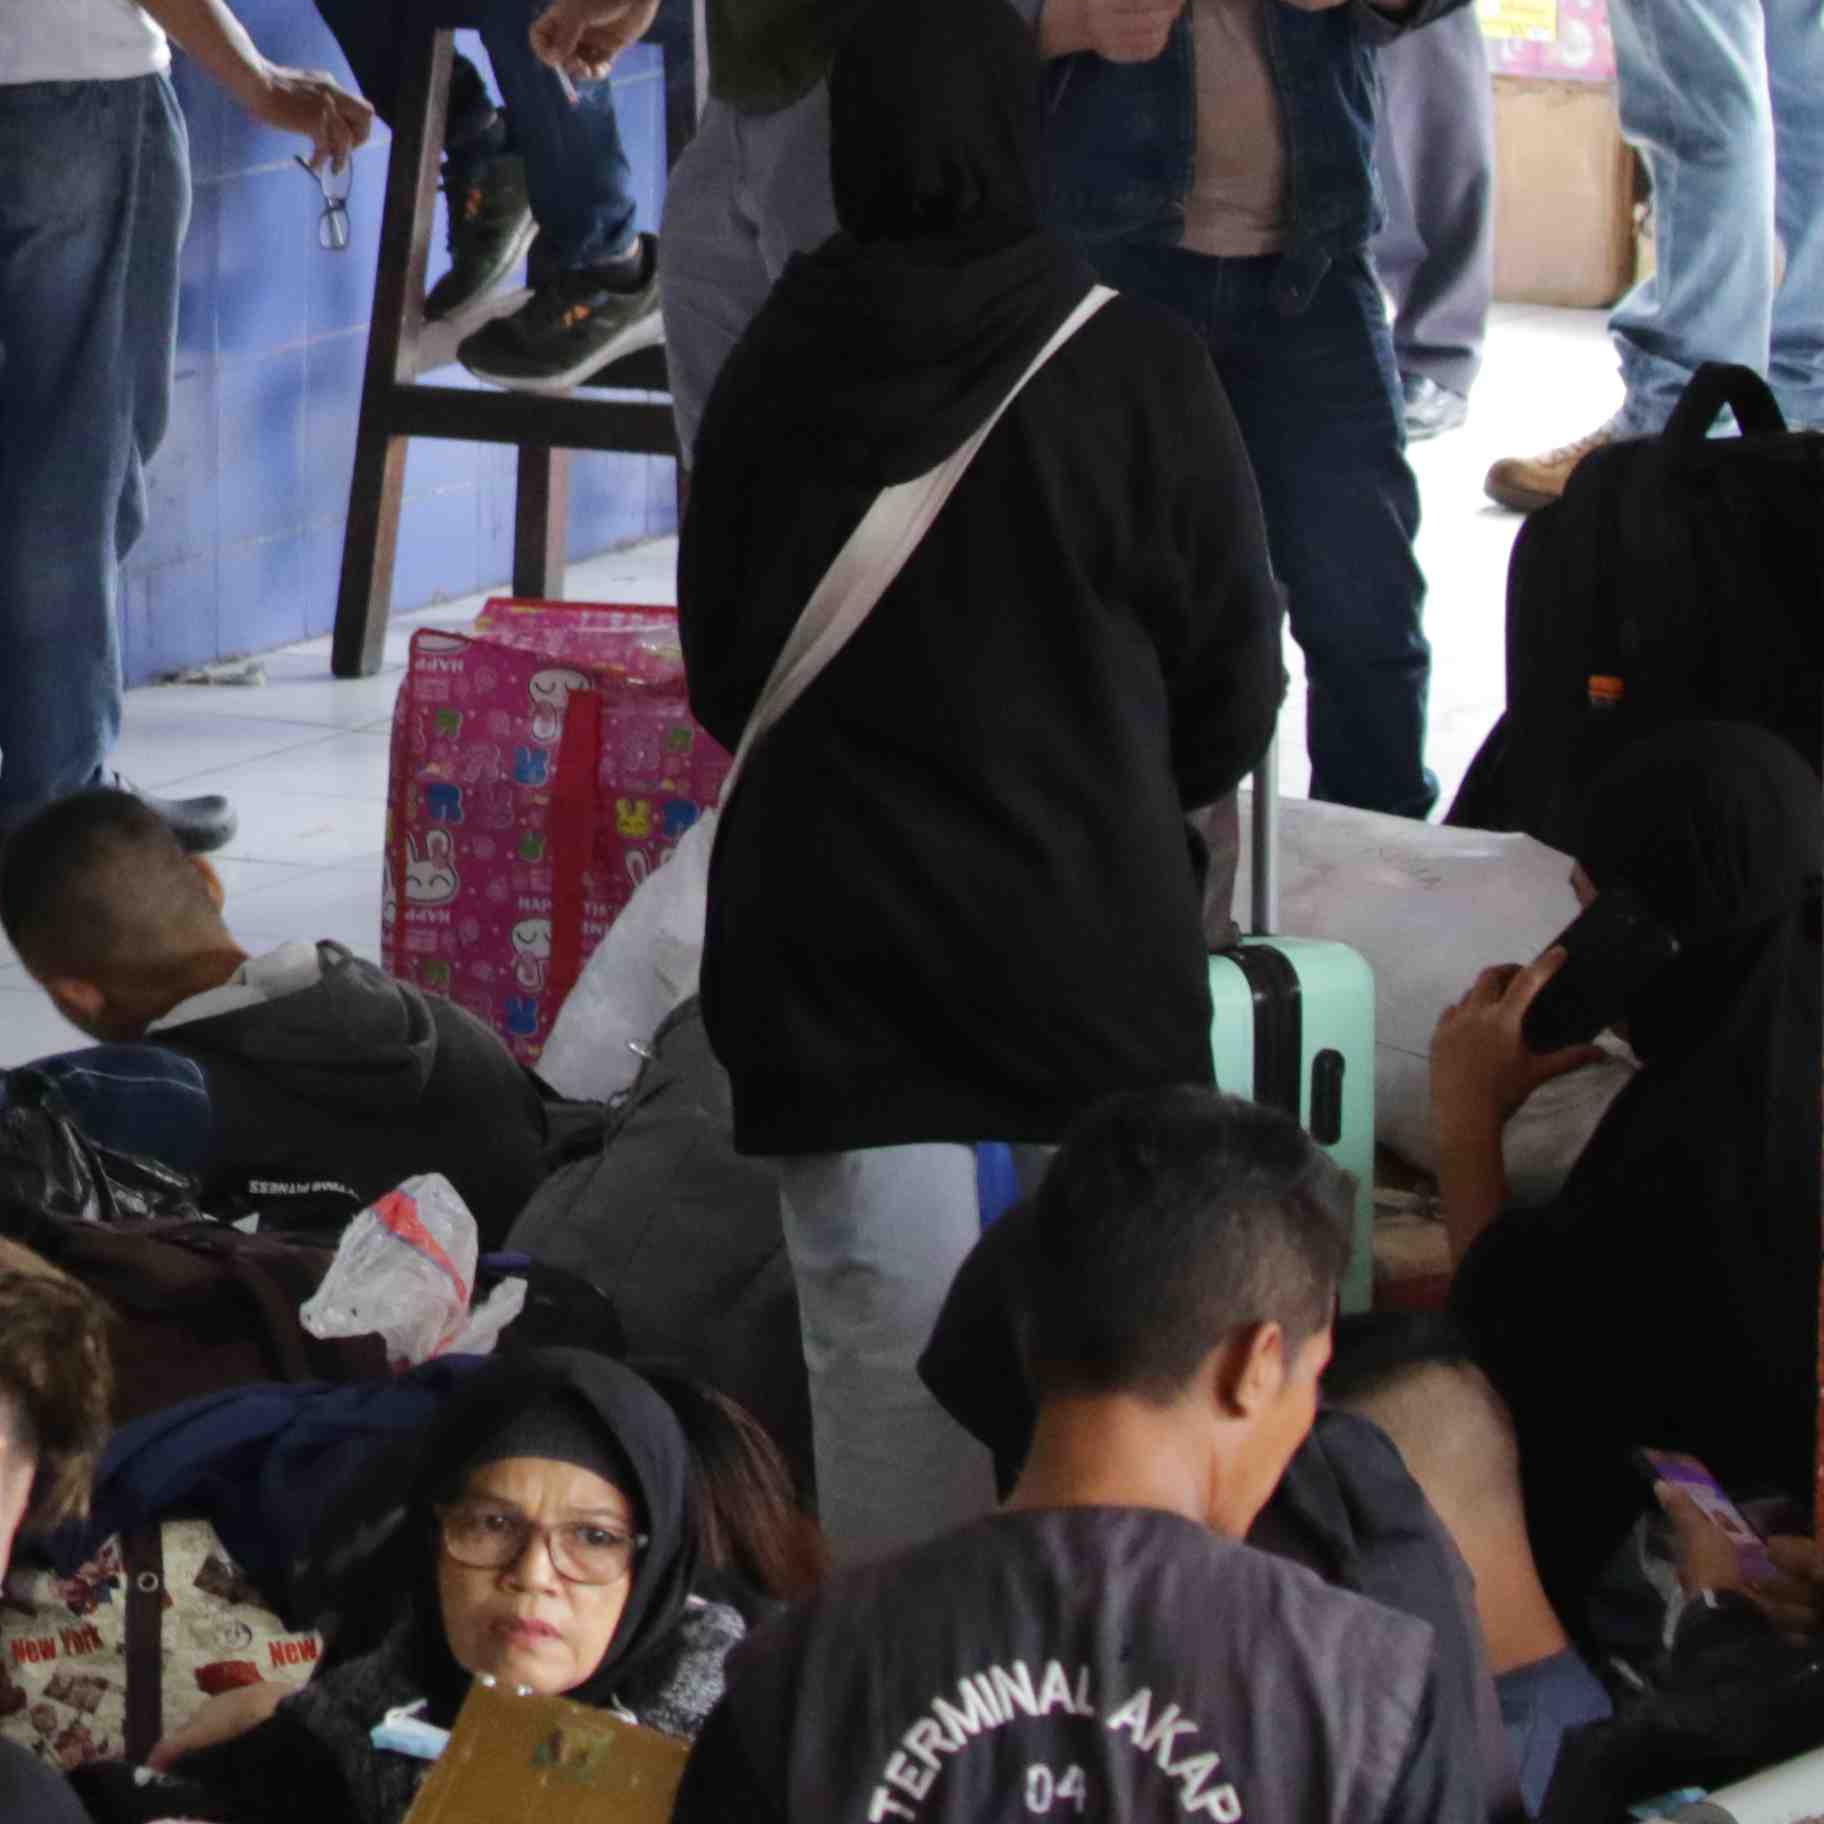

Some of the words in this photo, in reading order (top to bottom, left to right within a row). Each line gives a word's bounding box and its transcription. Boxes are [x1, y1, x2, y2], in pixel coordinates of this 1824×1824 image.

[870, 1660, 1095, 1824] TERMINAL
[1105, 1688, 1240, 1824] AKAP
[1024, 1764, 1087, 1815] 04
